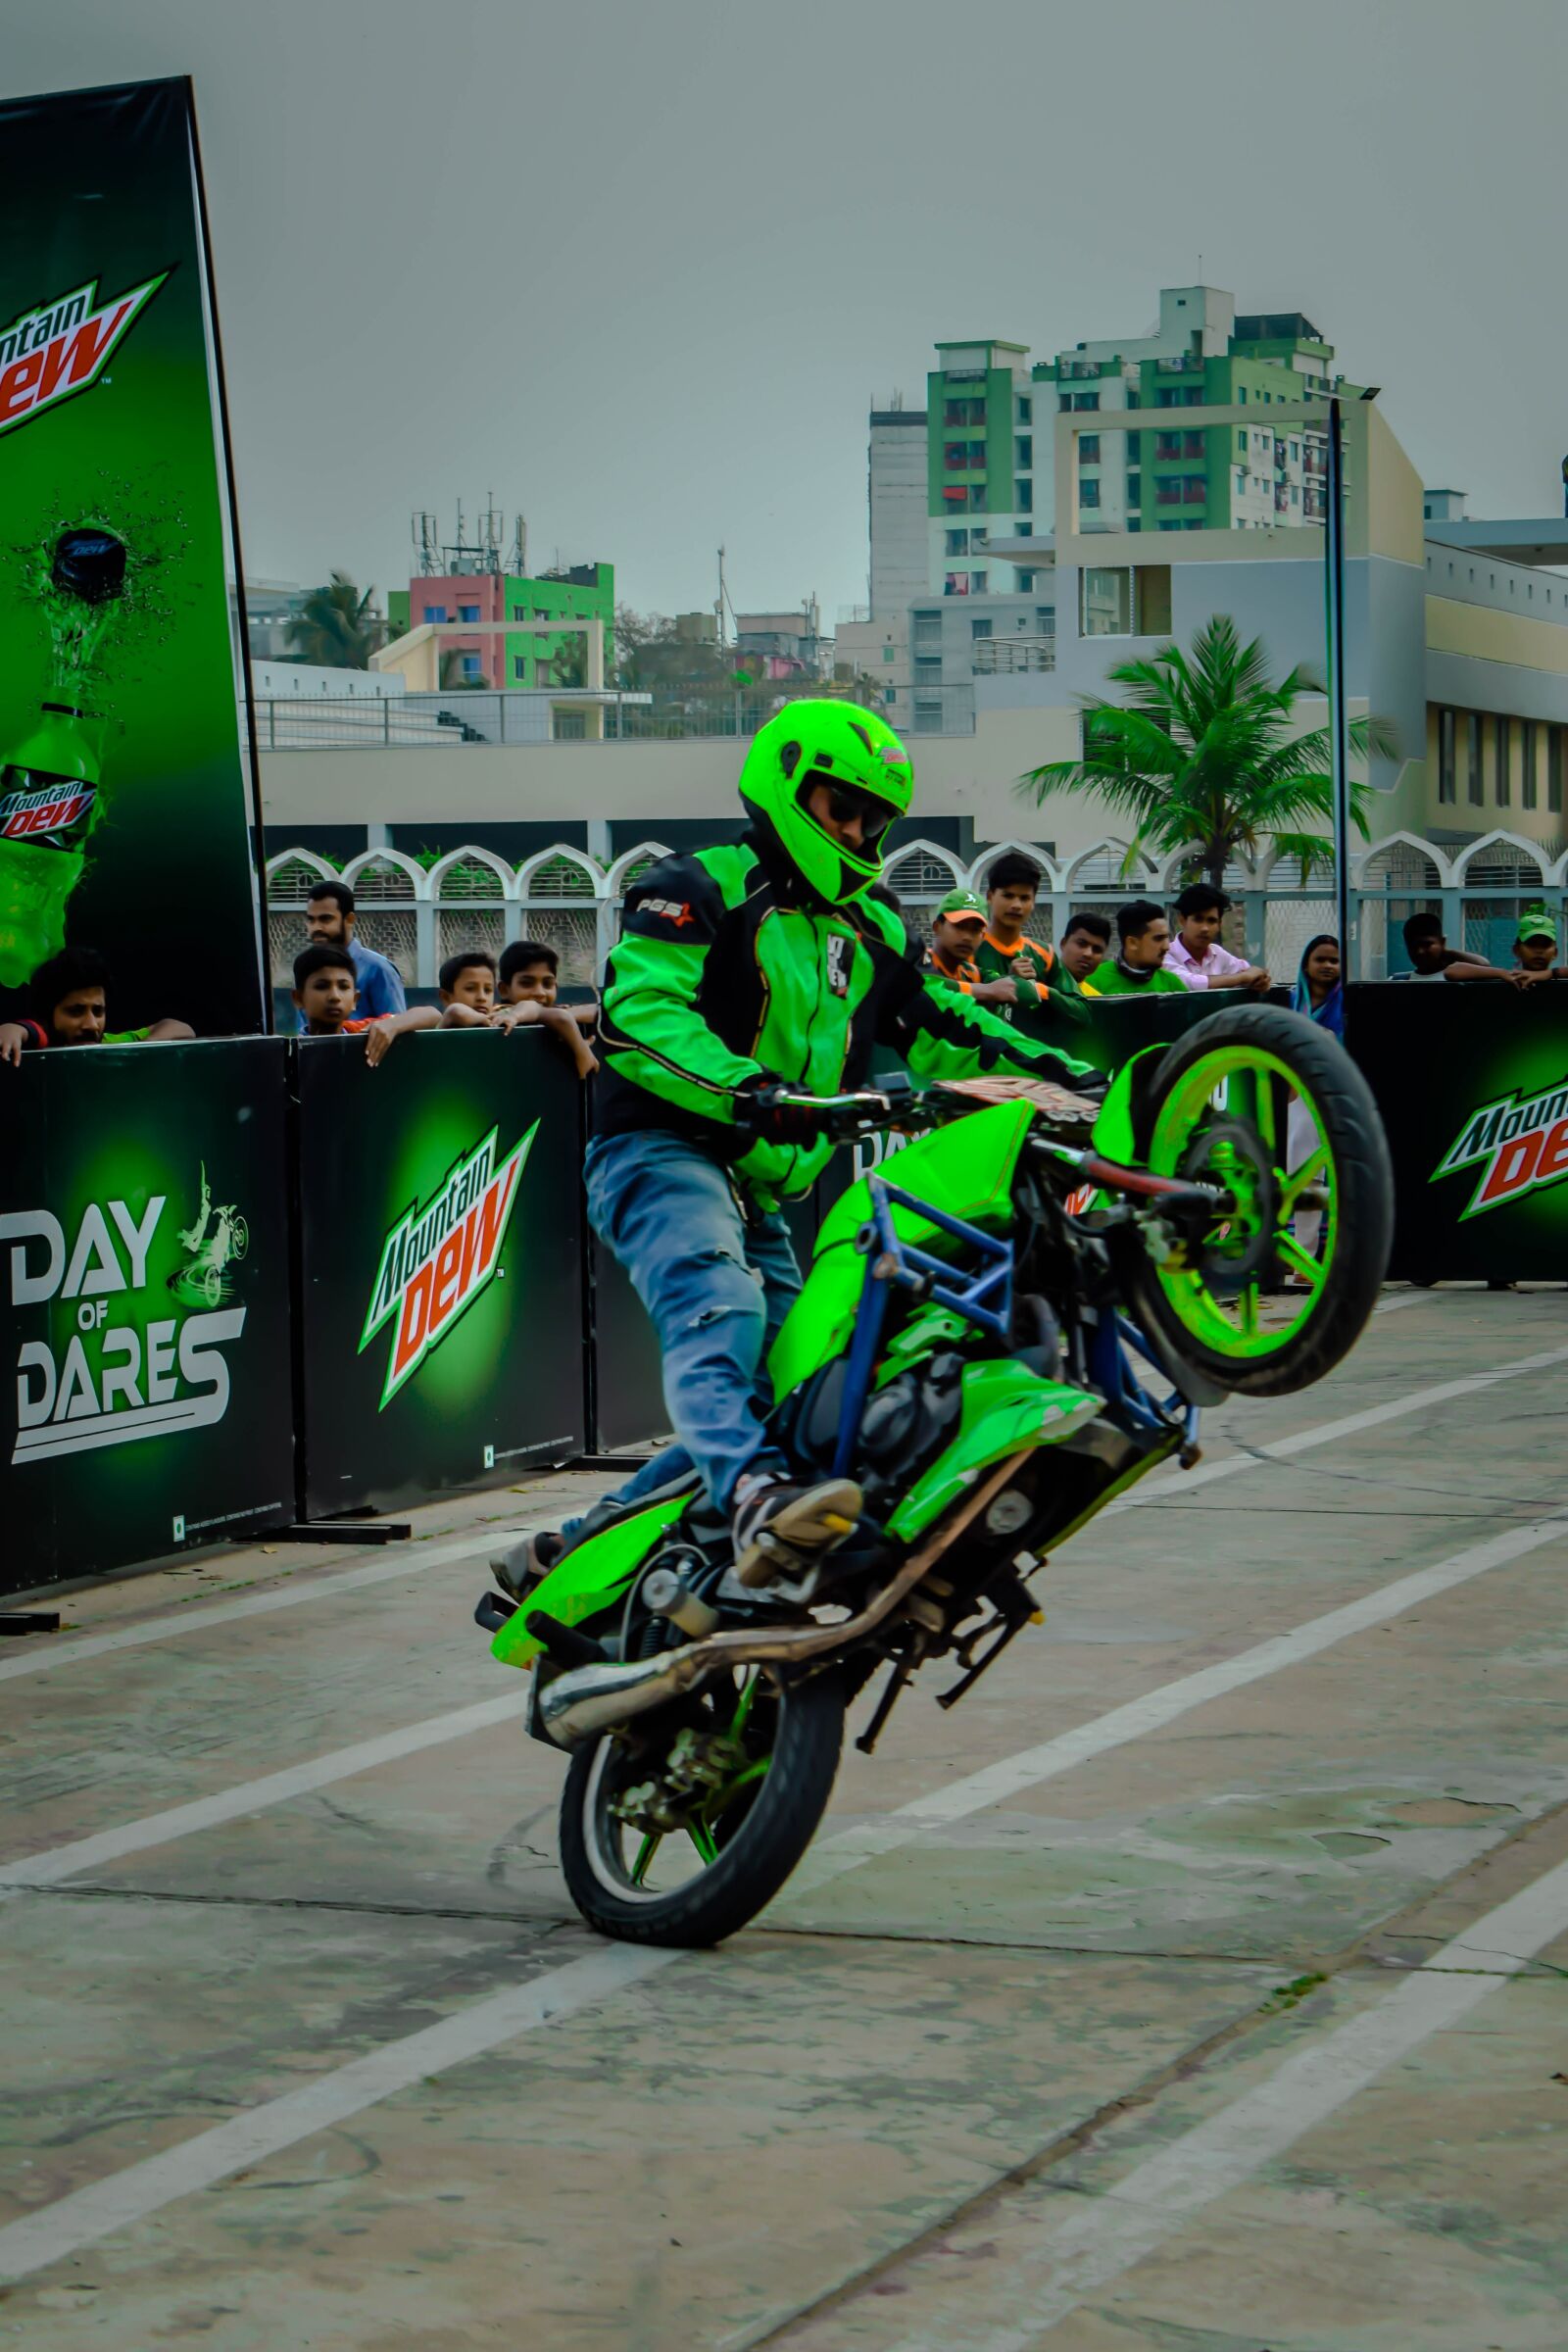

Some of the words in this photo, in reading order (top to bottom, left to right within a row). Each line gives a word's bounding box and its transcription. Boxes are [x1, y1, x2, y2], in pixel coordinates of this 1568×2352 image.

[0, 782, 82, 815] Mountain
[1447, 1090, 1568, 1166] Moun
[0, 1196, 167, 1305] DAY
[370, 1145, 491, 1323] Mountain
[77, 1300, 108, 1330] OF
[17, 1307, 247, 1429] DARES
